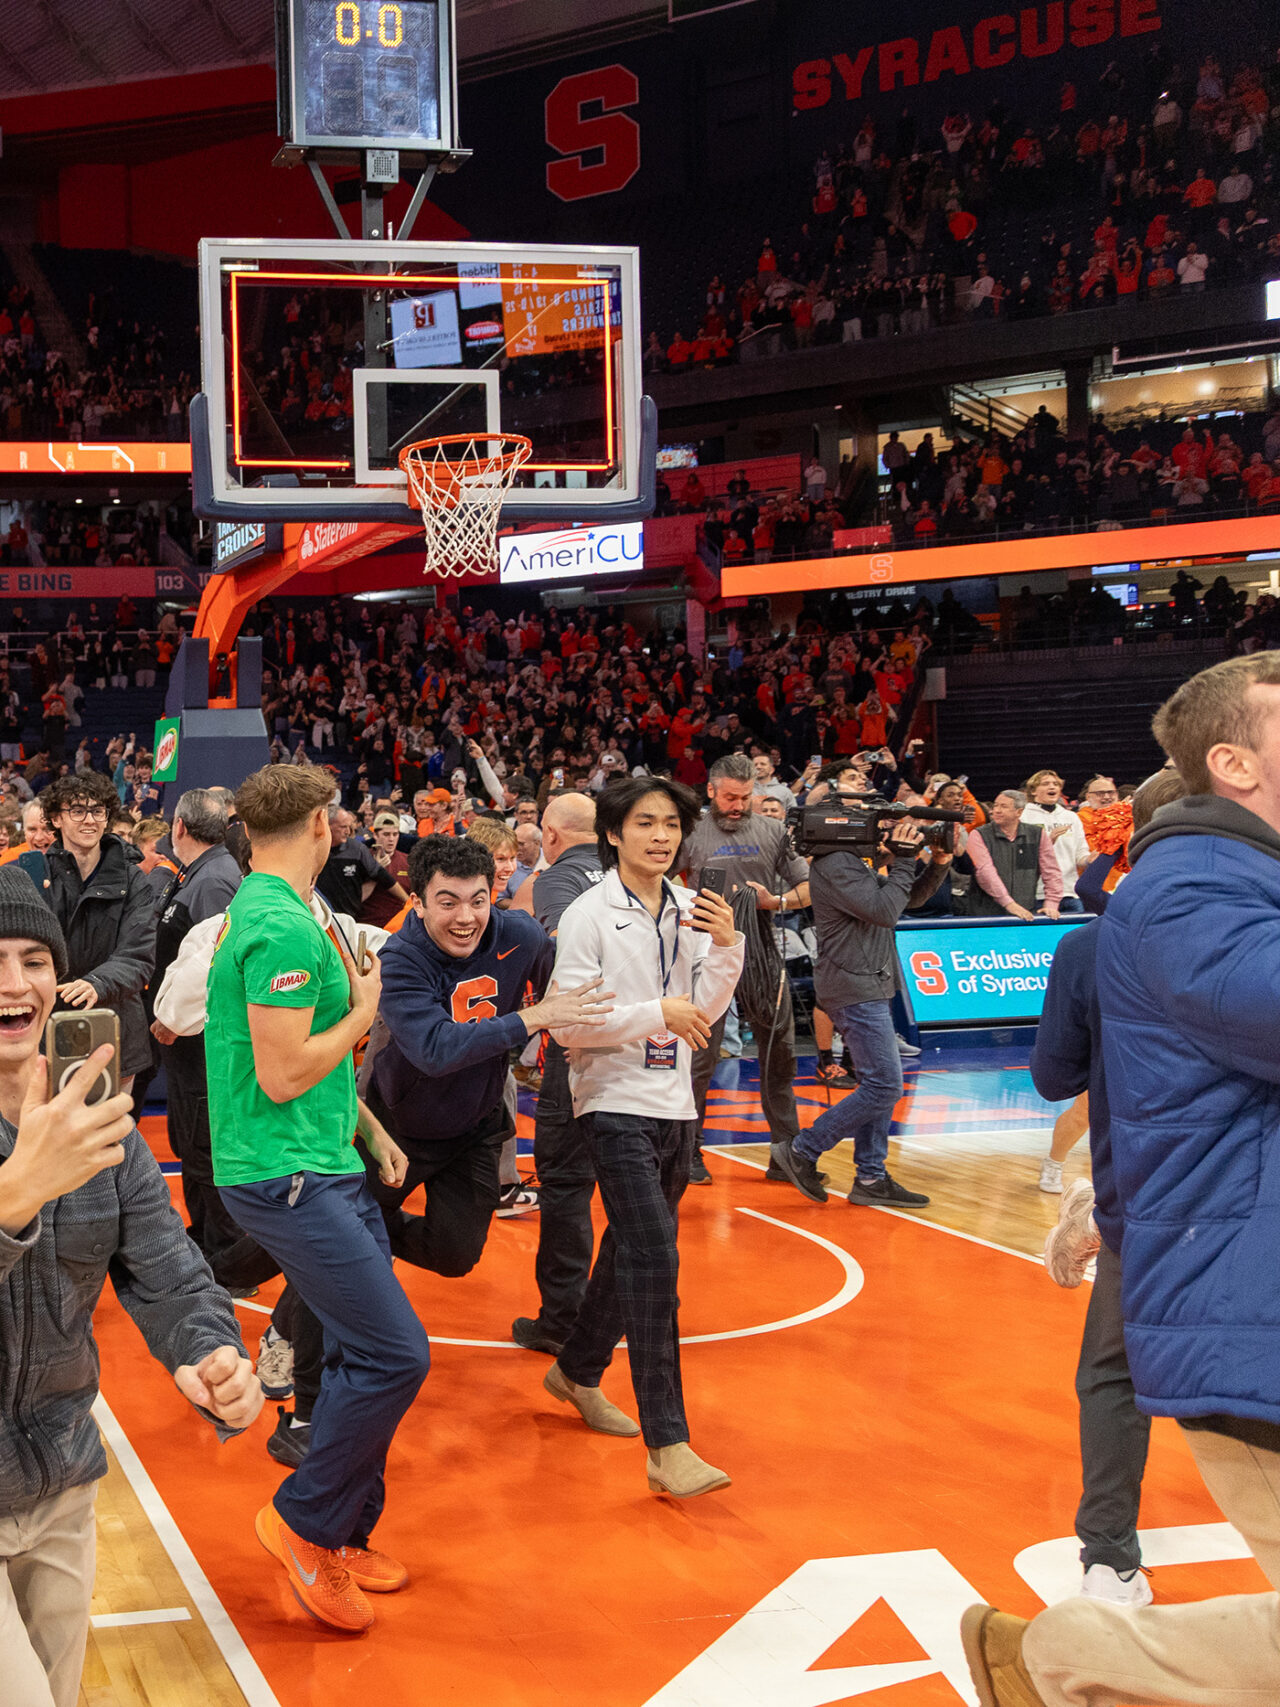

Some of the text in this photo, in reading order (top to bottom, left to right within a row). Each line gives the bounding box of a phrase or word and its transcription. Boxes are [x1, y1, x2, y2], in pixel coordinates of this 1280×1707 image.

[335, 2, 402, 48] 0.0
[792, 0, 1162, 111] SYRACUSE
[545, 64, 640, 201] S
[217, 523, 265, 561] CROUSE
[503, 531, 644, 572] AmeriCU
[17, 573, 73, 592] BING
[156, 575, 185, 590] 103
[830, 586, 916, 601] FRESTRY DRIVE
[909, 951, 949, 996] S
[950, 948, 1054, 972] Exclusive
[269, 972, 308, 994] LIBMAN
[957, 974, 979, 994] of
